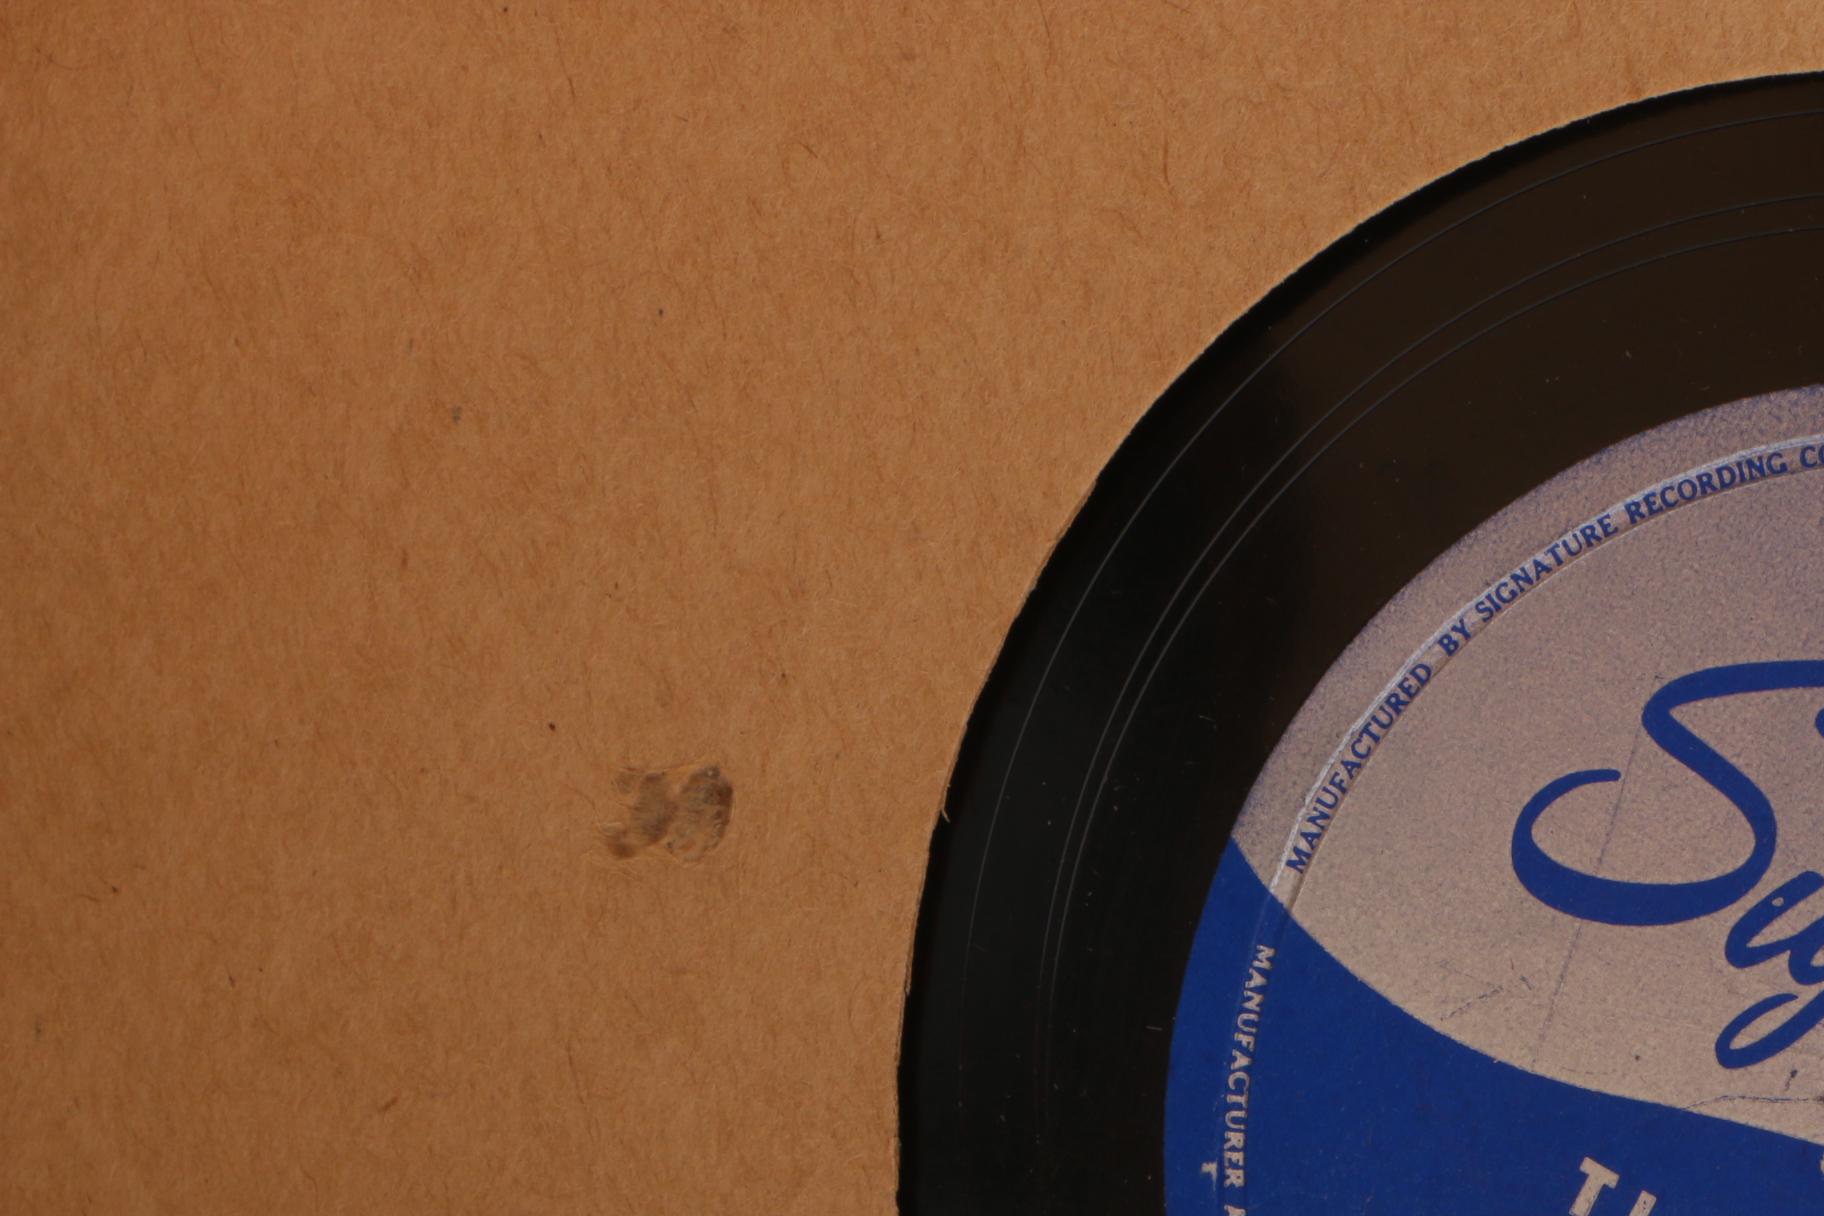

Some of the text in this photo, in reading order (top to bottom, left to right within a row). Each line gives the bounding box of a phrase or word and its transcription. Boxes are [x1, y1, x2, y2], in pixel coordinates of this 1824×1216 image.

[1285, 662, 1432, 874] MANUFACTURED
[1437, 618, 1473, 657] BY
[1474, 514, 1618, 624] SIGNATURE
[1623, 449, 1788, 524] RECORDING
[1223, 944, 1276, 1188] MANUFACTURER
